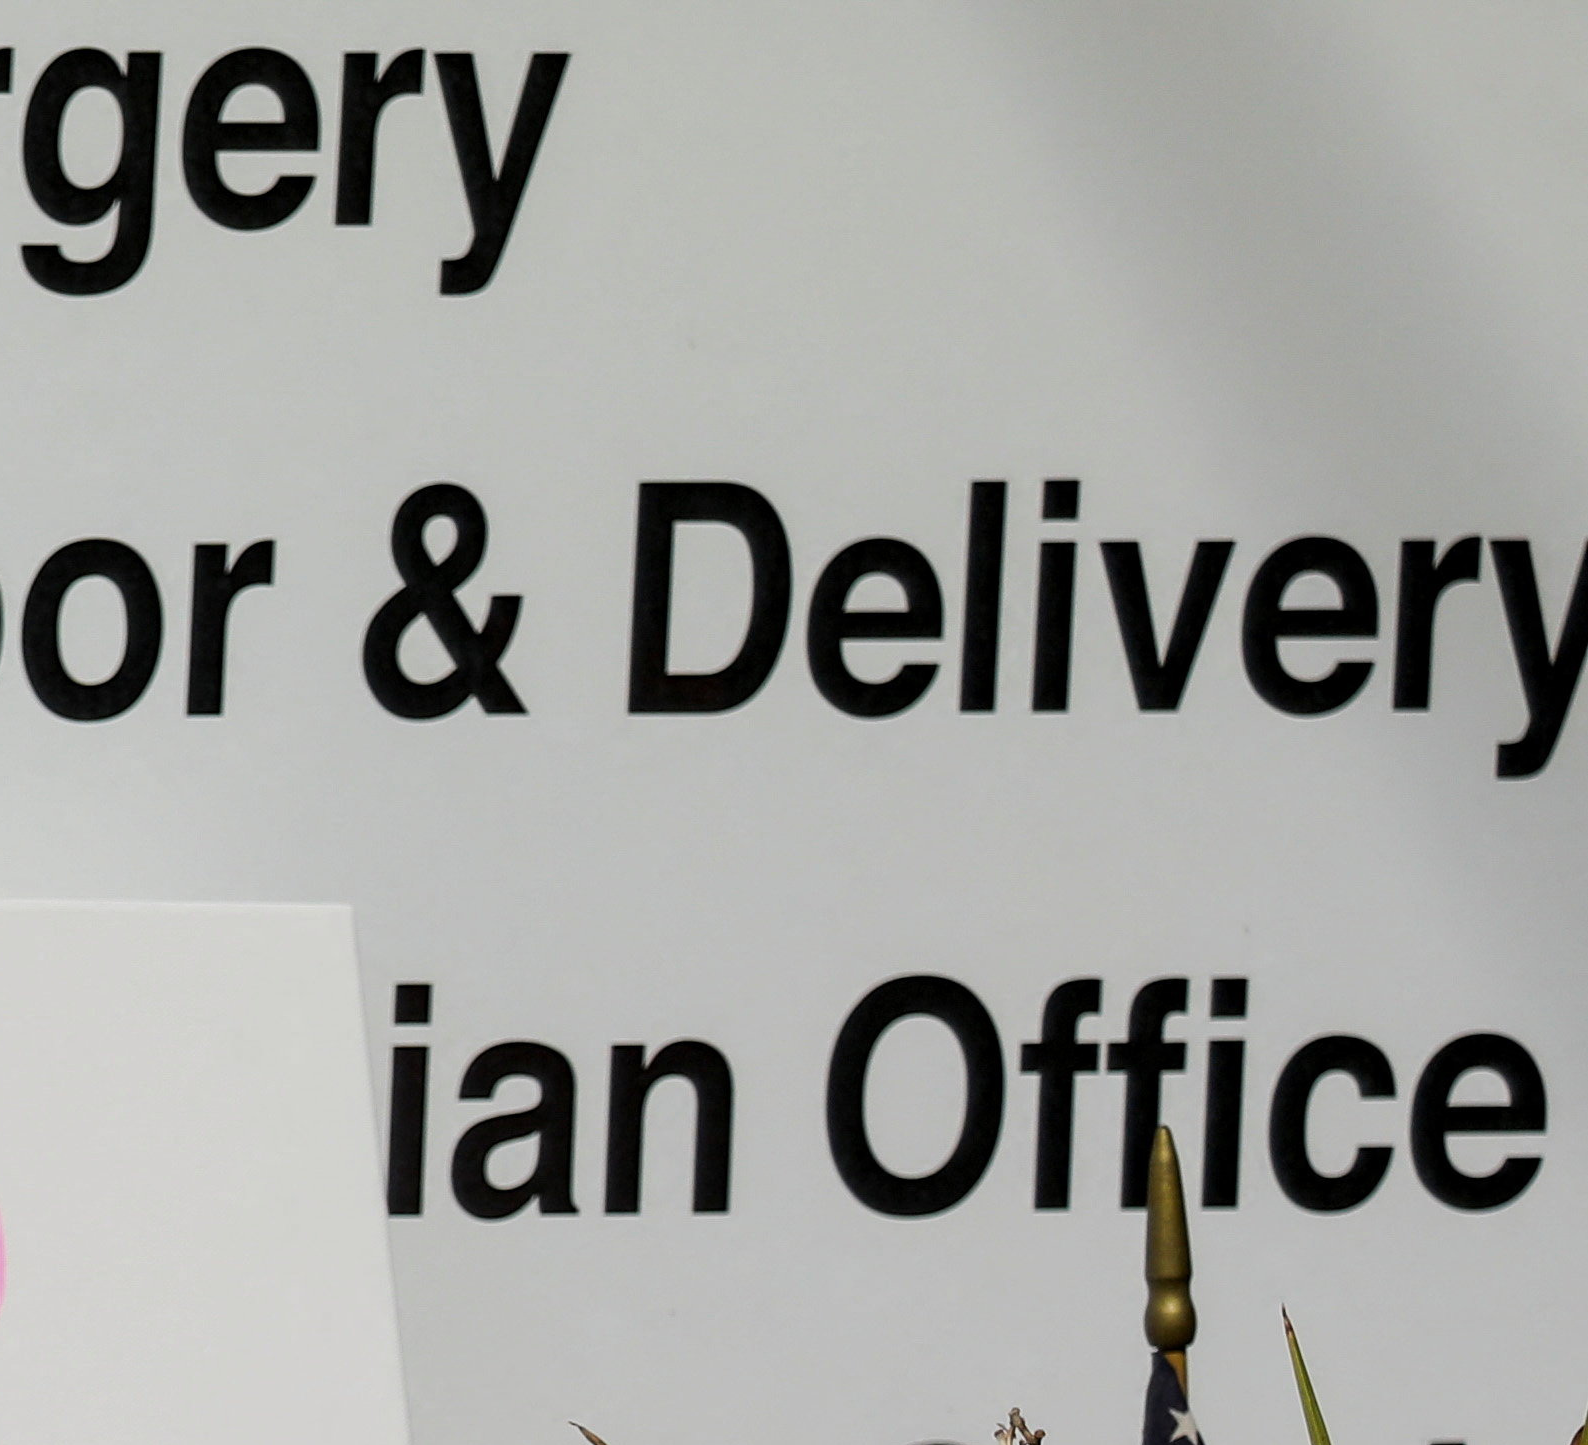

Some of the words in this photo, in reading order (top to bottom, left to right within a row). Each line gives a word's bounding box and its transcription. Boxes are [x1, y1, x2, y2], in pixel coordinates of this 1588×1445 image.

[361, 481, 529, 722] &
[626, 478, 1588, 781] Delivery
[824, 973, 1549, 1219] Office
